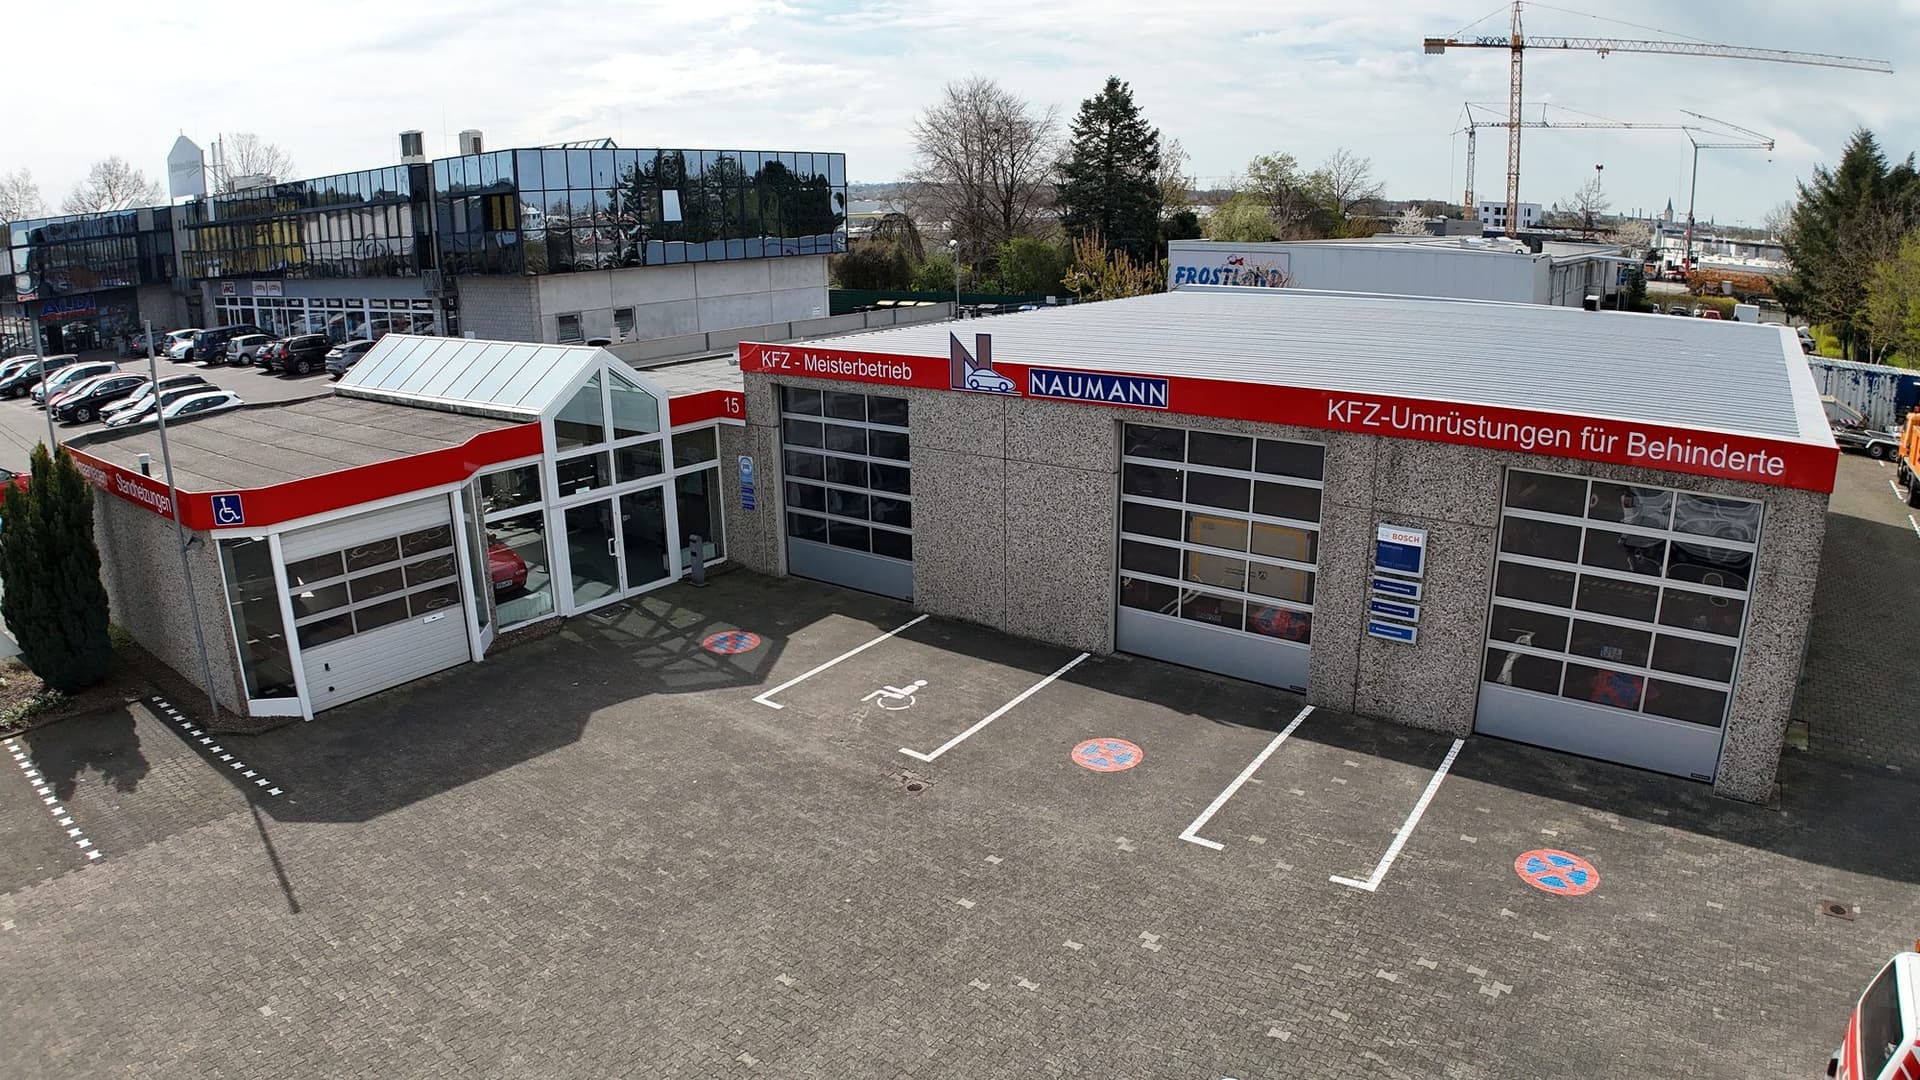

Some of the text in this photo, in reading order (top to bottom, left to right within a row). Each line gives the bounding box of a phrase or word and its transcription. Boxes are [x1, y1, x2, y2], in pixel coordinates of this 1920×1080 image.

[41, 295, 96, 317] ALDI
[760, 350, 791, 370] KFZ
[803, 353, 913, 381] Meisterbetrieb
[950, 332, 992, 390] N
[723, 396, 740, 415] 15
[1031, 373, 1167, 406] NAUMANN
[1326, 398, 1786, 476] KFZ-Umrüstungen für Behinderte
[115, 473, 172, 513] Standheizungen
[1392, 533, 1420, 544] BOSCH
